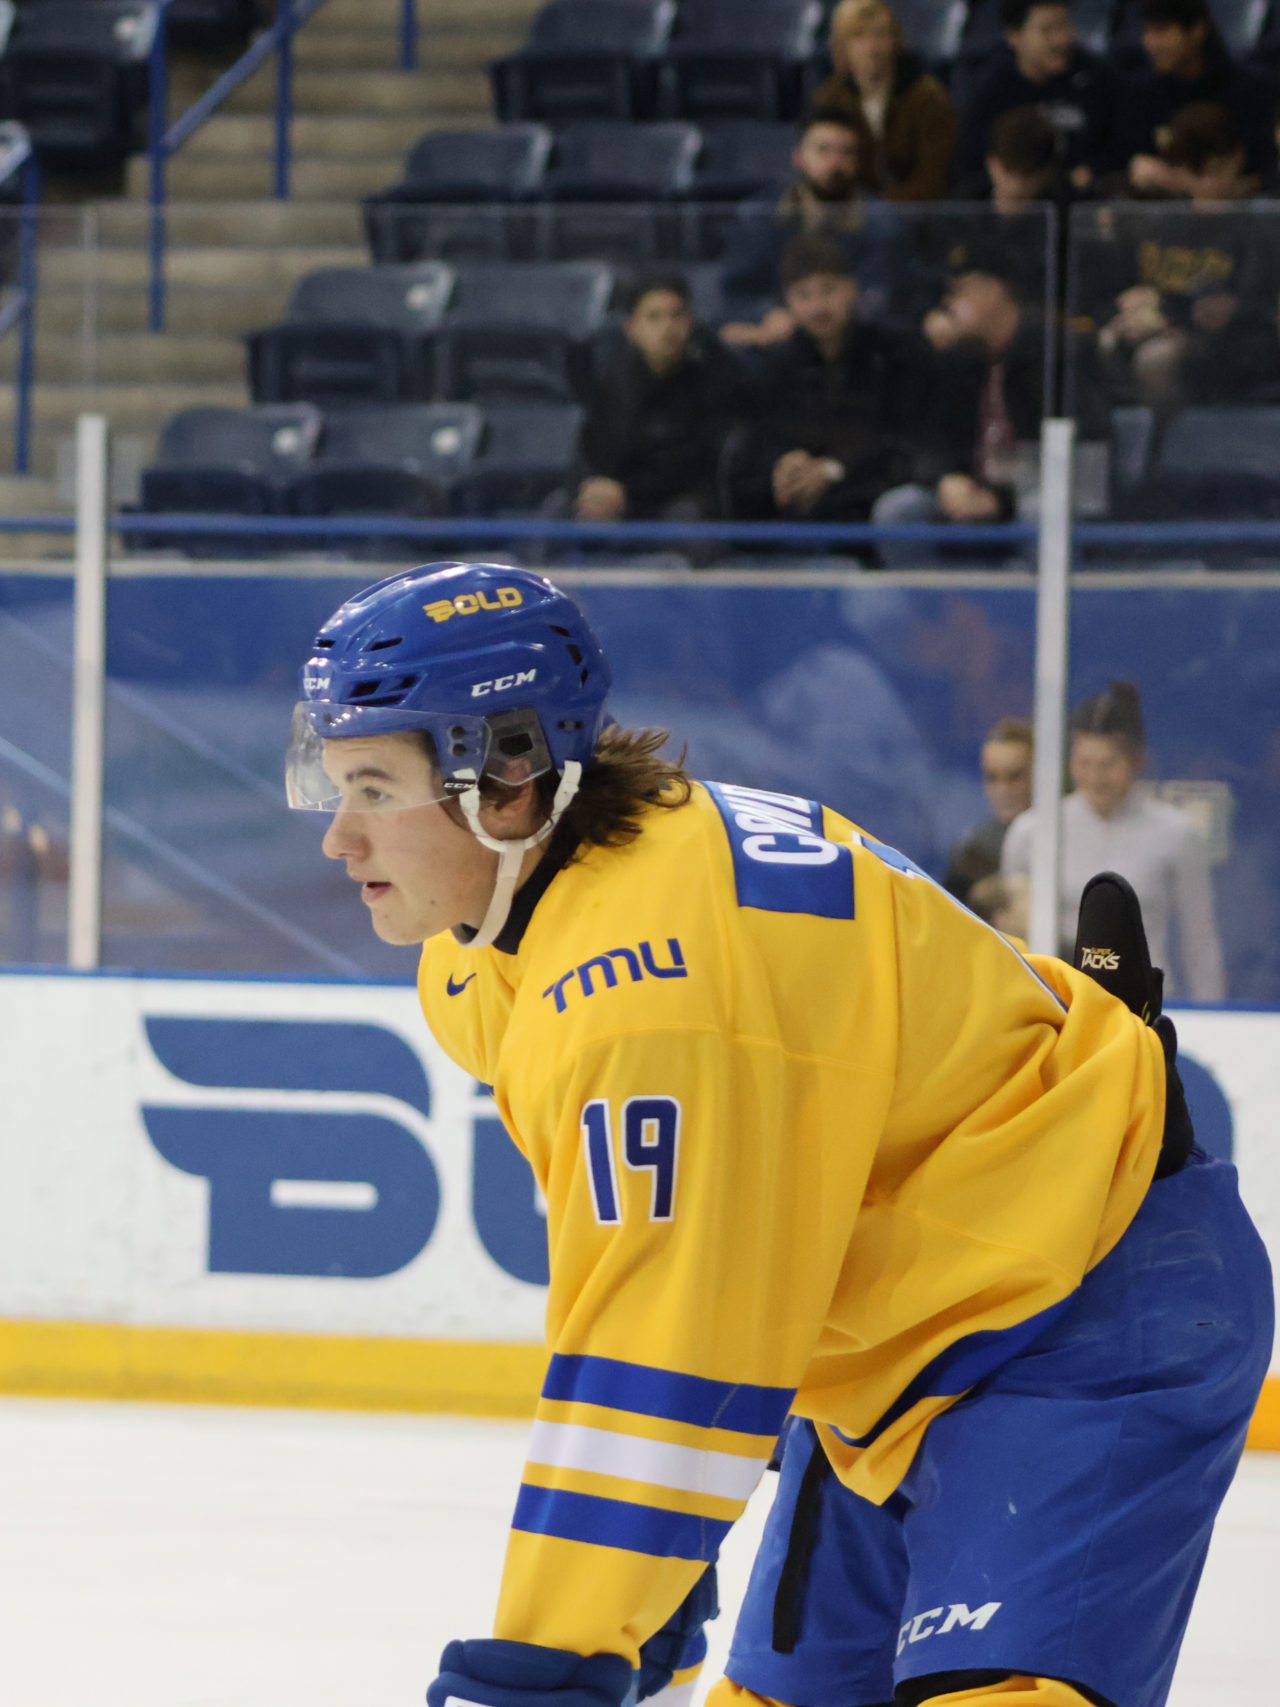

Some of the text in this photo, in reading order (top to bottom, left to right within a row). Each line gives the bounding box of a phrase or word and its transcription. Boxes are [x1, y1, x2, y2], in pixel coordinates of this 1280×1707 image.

[423, 587, 523, 623] BOLD
[472, 668, 537, 697] CCM
[542, 938, 688, 1014] TMU
[1081, 947, 1120, 970] TACKS
[580, 1095, 682, 1225] 19
